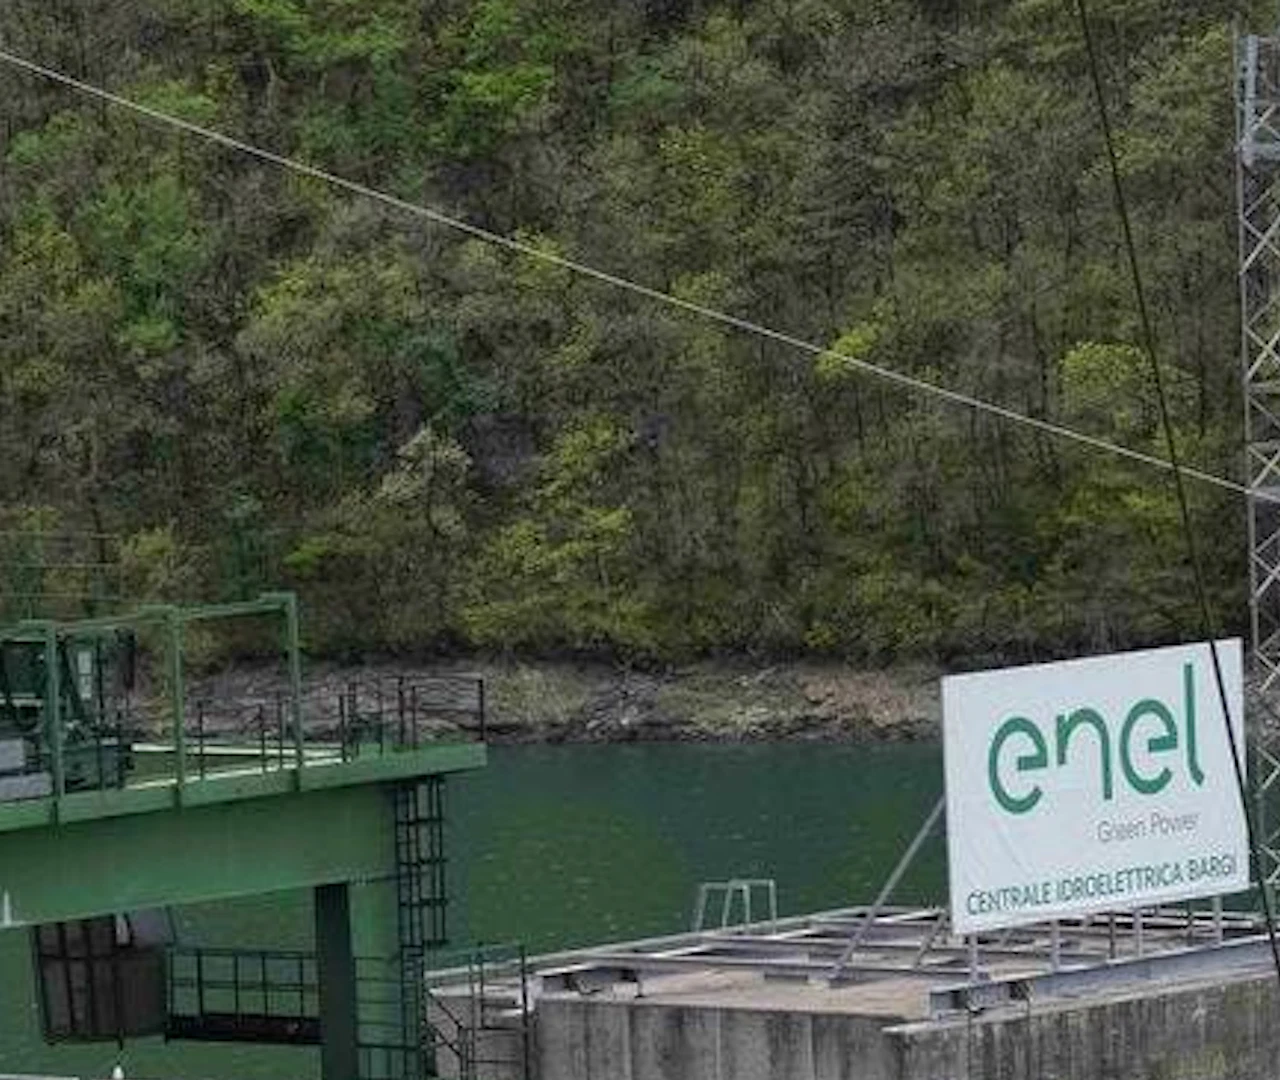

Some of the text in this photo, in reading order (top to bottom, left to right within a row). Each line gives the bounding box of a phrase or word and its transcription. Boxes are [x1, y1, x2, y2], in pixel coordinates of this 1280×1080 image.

[988, 663, 1205, 815] enel
[1097, 811, 1199, 843] Green Power
[967, 854, 1237, 915] CENTRALE IDROELETTRICA BARGI
